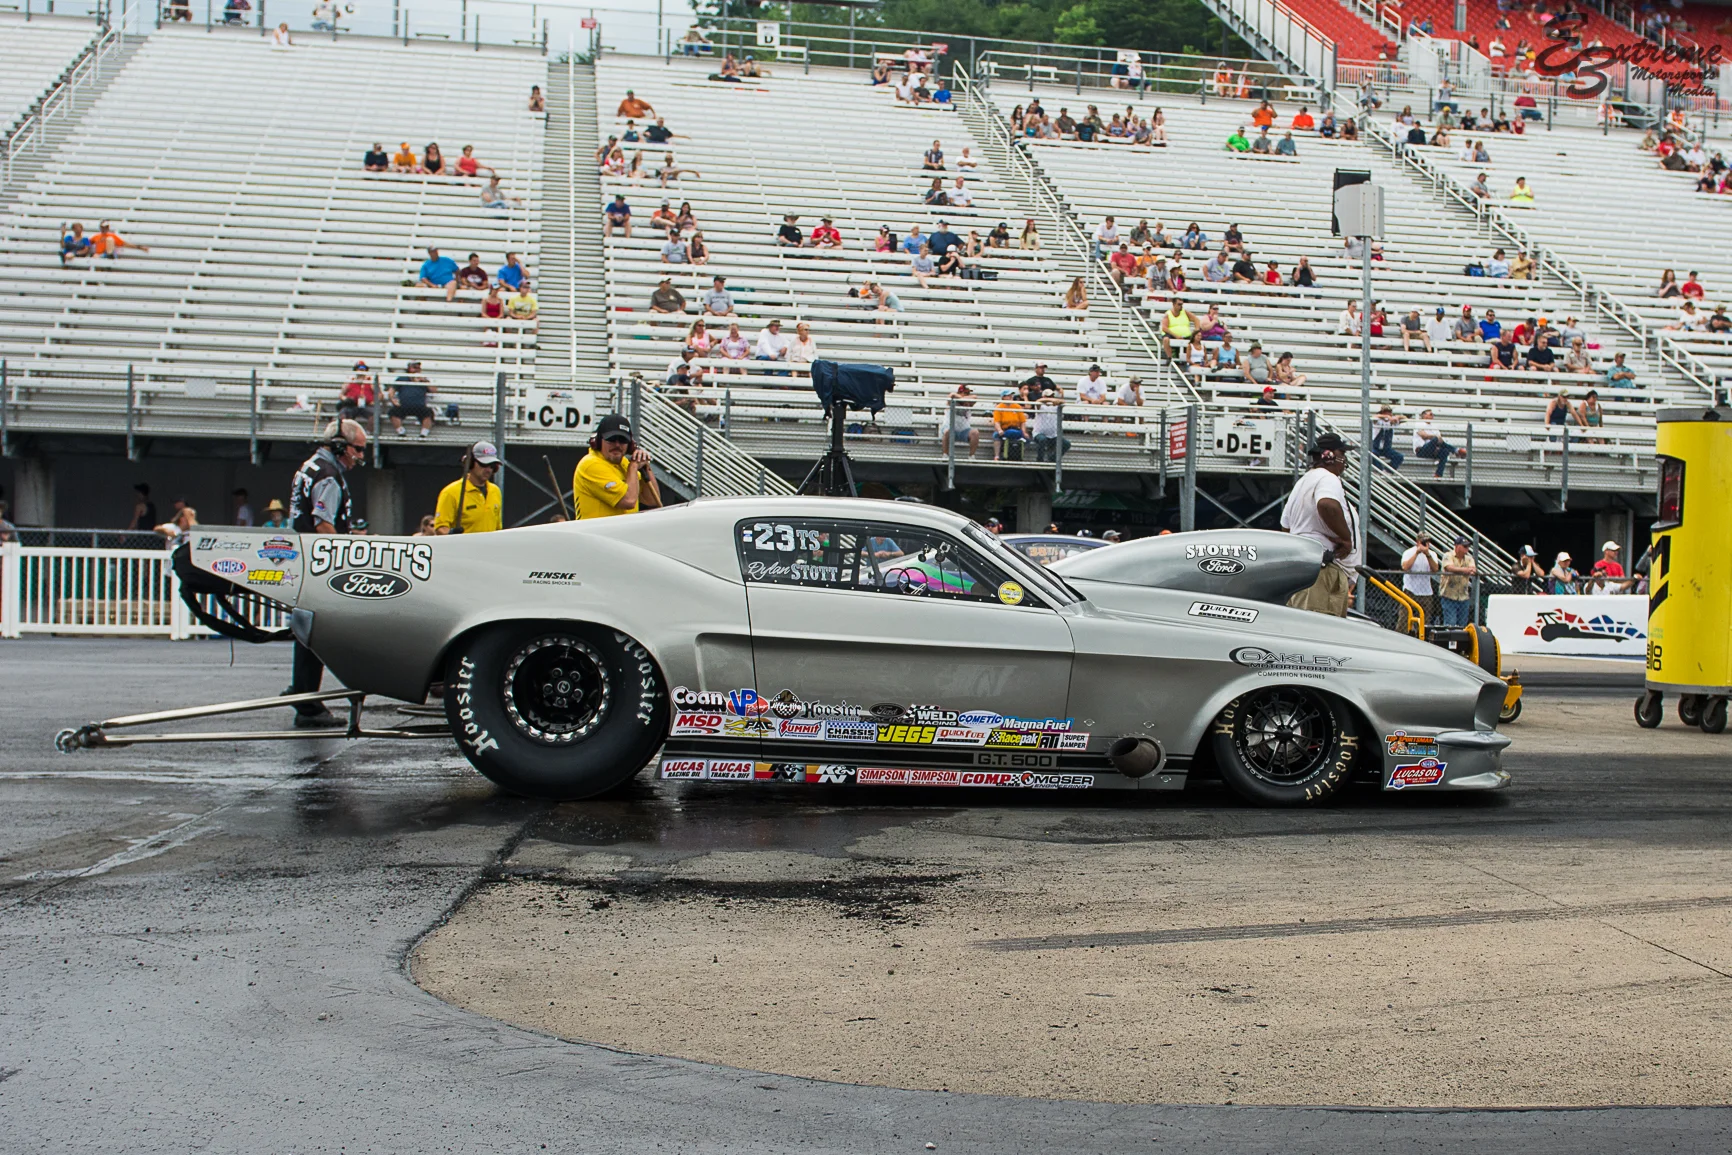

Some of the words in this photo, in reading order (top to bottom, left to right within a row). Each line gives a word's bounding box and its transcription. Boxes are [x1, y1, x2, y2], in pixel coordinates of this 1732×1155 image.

[753, 523, 796, 552] 23
[796, 529, 821, 551] TS
[1185, 544, 1257, 561] STOTT'S
[310, 538, 432, 581] STOTT'S
[217, 561, 243, 573] NHRA
[747, 562, 791, 580] Dylan
[791, 563, 838, 582] STOTT
[1206, 560, 1236, 573] Ford
[248, 569, 284, 581] JEGS
[529, 571, 577, 580] PENSKE
[343, 573, 396, 596] Ford
[1229, 646, 1352, 667] OAKLEY
[1249, 663, 1337, 673] MOTORSPORTS
[1257, 671, 1299, 679] COMPETITION
[672, 687, 724, 705] Coan
[450, 656, 500, 757] Hoosier
[729, 689, 757, 716] VP
[801, 700, 862, 719] Hoosier
[876, 706, 898, 715] Ford
[917, 710, 957, 721] WELD
[676, 715, 722, 727] MSD
[958, 714, 1003, 724] COMETIC
[1003, 718, 1071, 731] MagnaFuel
[780, 720, 820, 734] SUMMIT
[827, 728, 874, 736] CHASSIS
[877, 725, 937, 744] JEGS
[940, 729, 964, 738] QUICK
[965, 730, 986, 739] FUEL
[1000, 731, 1038, 744] Racepak
[1011, 754, 1052, 767] 500
[1305, 730, 1359, 801] Hoosier
[665, 762, 705, 772] LUCAS
[711, 763, 752, 773] LUCAS
[815, 764, 856, 784] K&N
[860, 769, 906, 780] SIMPSON
[911, 771, 958, 782] SIMPSON
[962, 773, 1012, 785] COMP
[1395, 769, 1425, 779] LUCAS
[1425, 768, 1439, 777] OIL
[1034, 775, 1094, 785] MOSER
